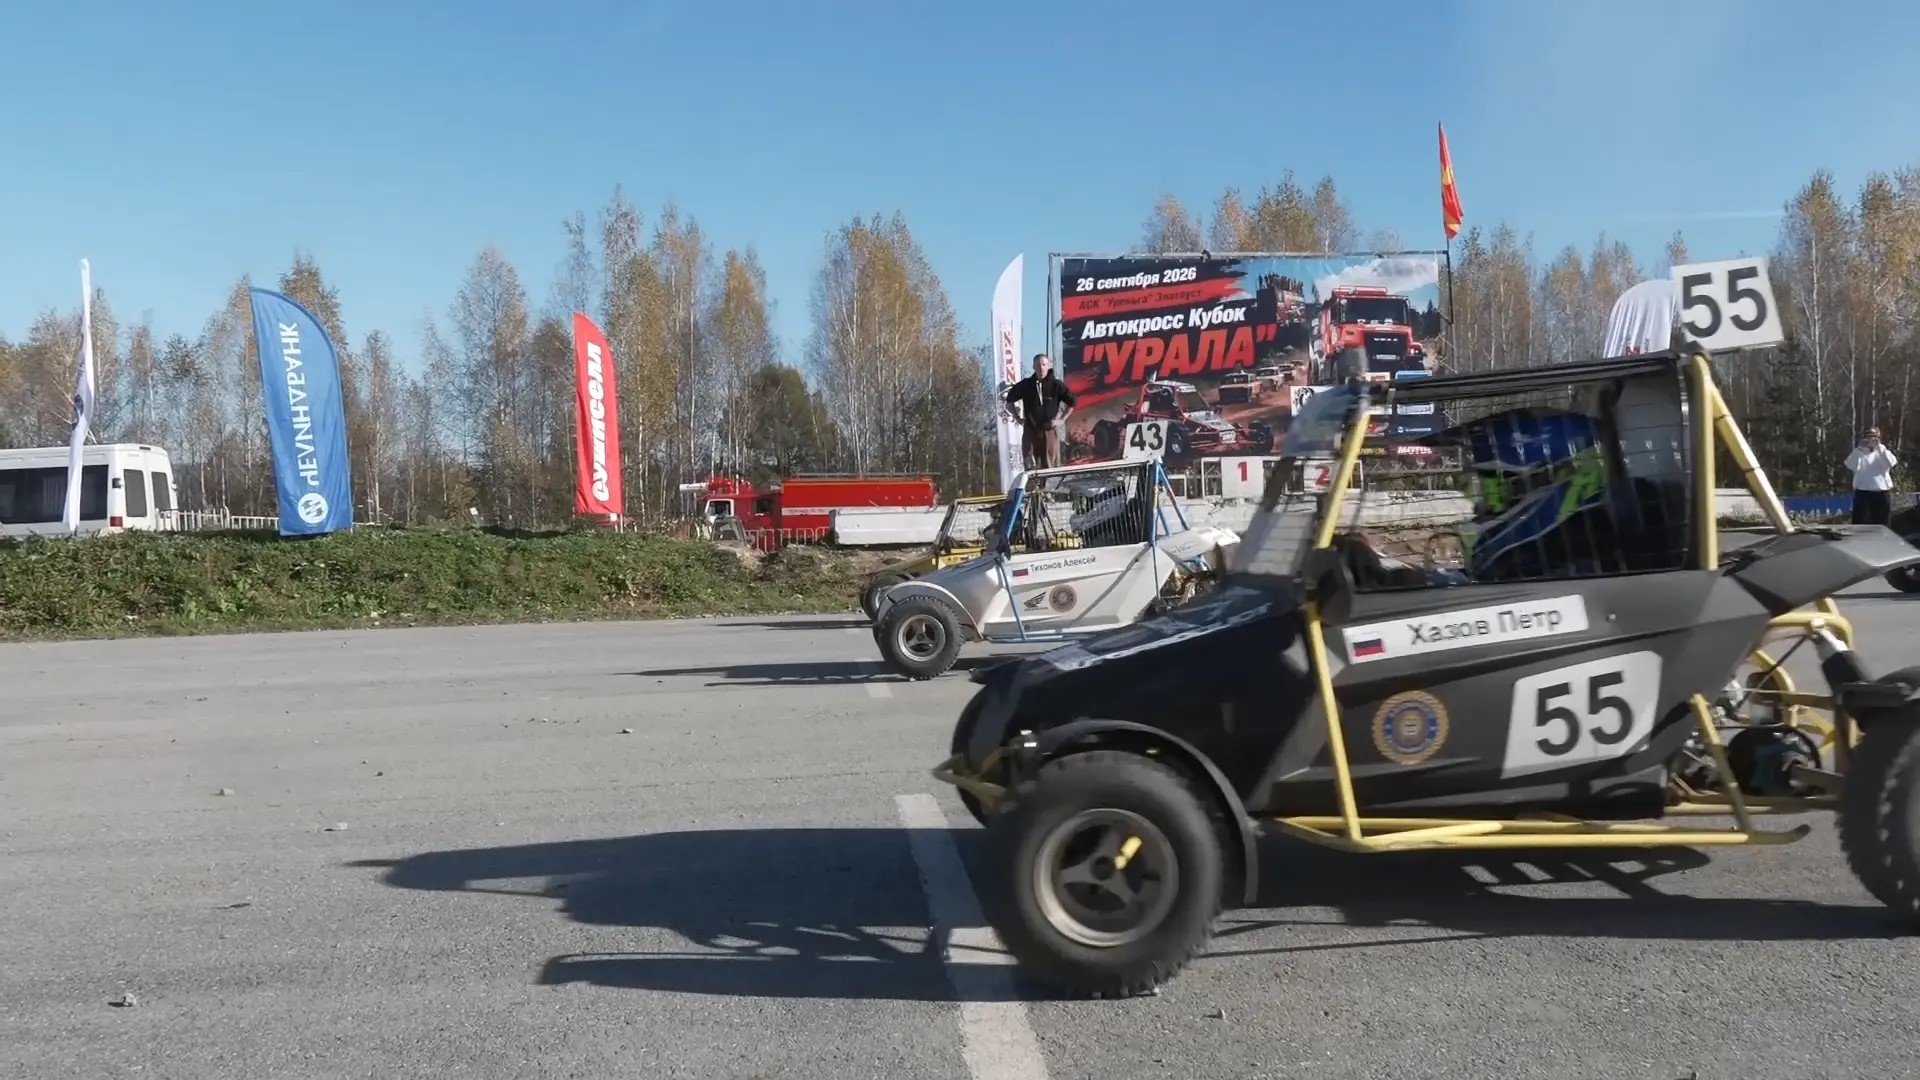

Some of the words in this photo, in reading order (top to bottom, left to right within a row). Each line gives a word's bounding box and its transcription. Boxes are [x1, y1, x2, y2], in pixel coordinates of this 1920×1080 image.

[1076, 277, 1095, 292] 26
[1097, 272, 1160, 289] сентября
[1163, 266, 1197, 283] 2026
[1682, 265, 1768, 338] 55
[1080, 313, 1185, 340] Автокросс
[1188, 304, 1248, 330] Кубок
[1083, 323, 1277, 385] "УРАЛА"
[1130, 423, 1164, 451] 43
[1237, 461, 1248, 482] 1
[1315, 466, 1330, 486] 2
[1029, 560, 1062, 573] Тихонов
[1063, 554, 1097, 568] Алексей
[1406, 619, 1491, 645] Хазов
[1536, 670, 1633, 757] 55
